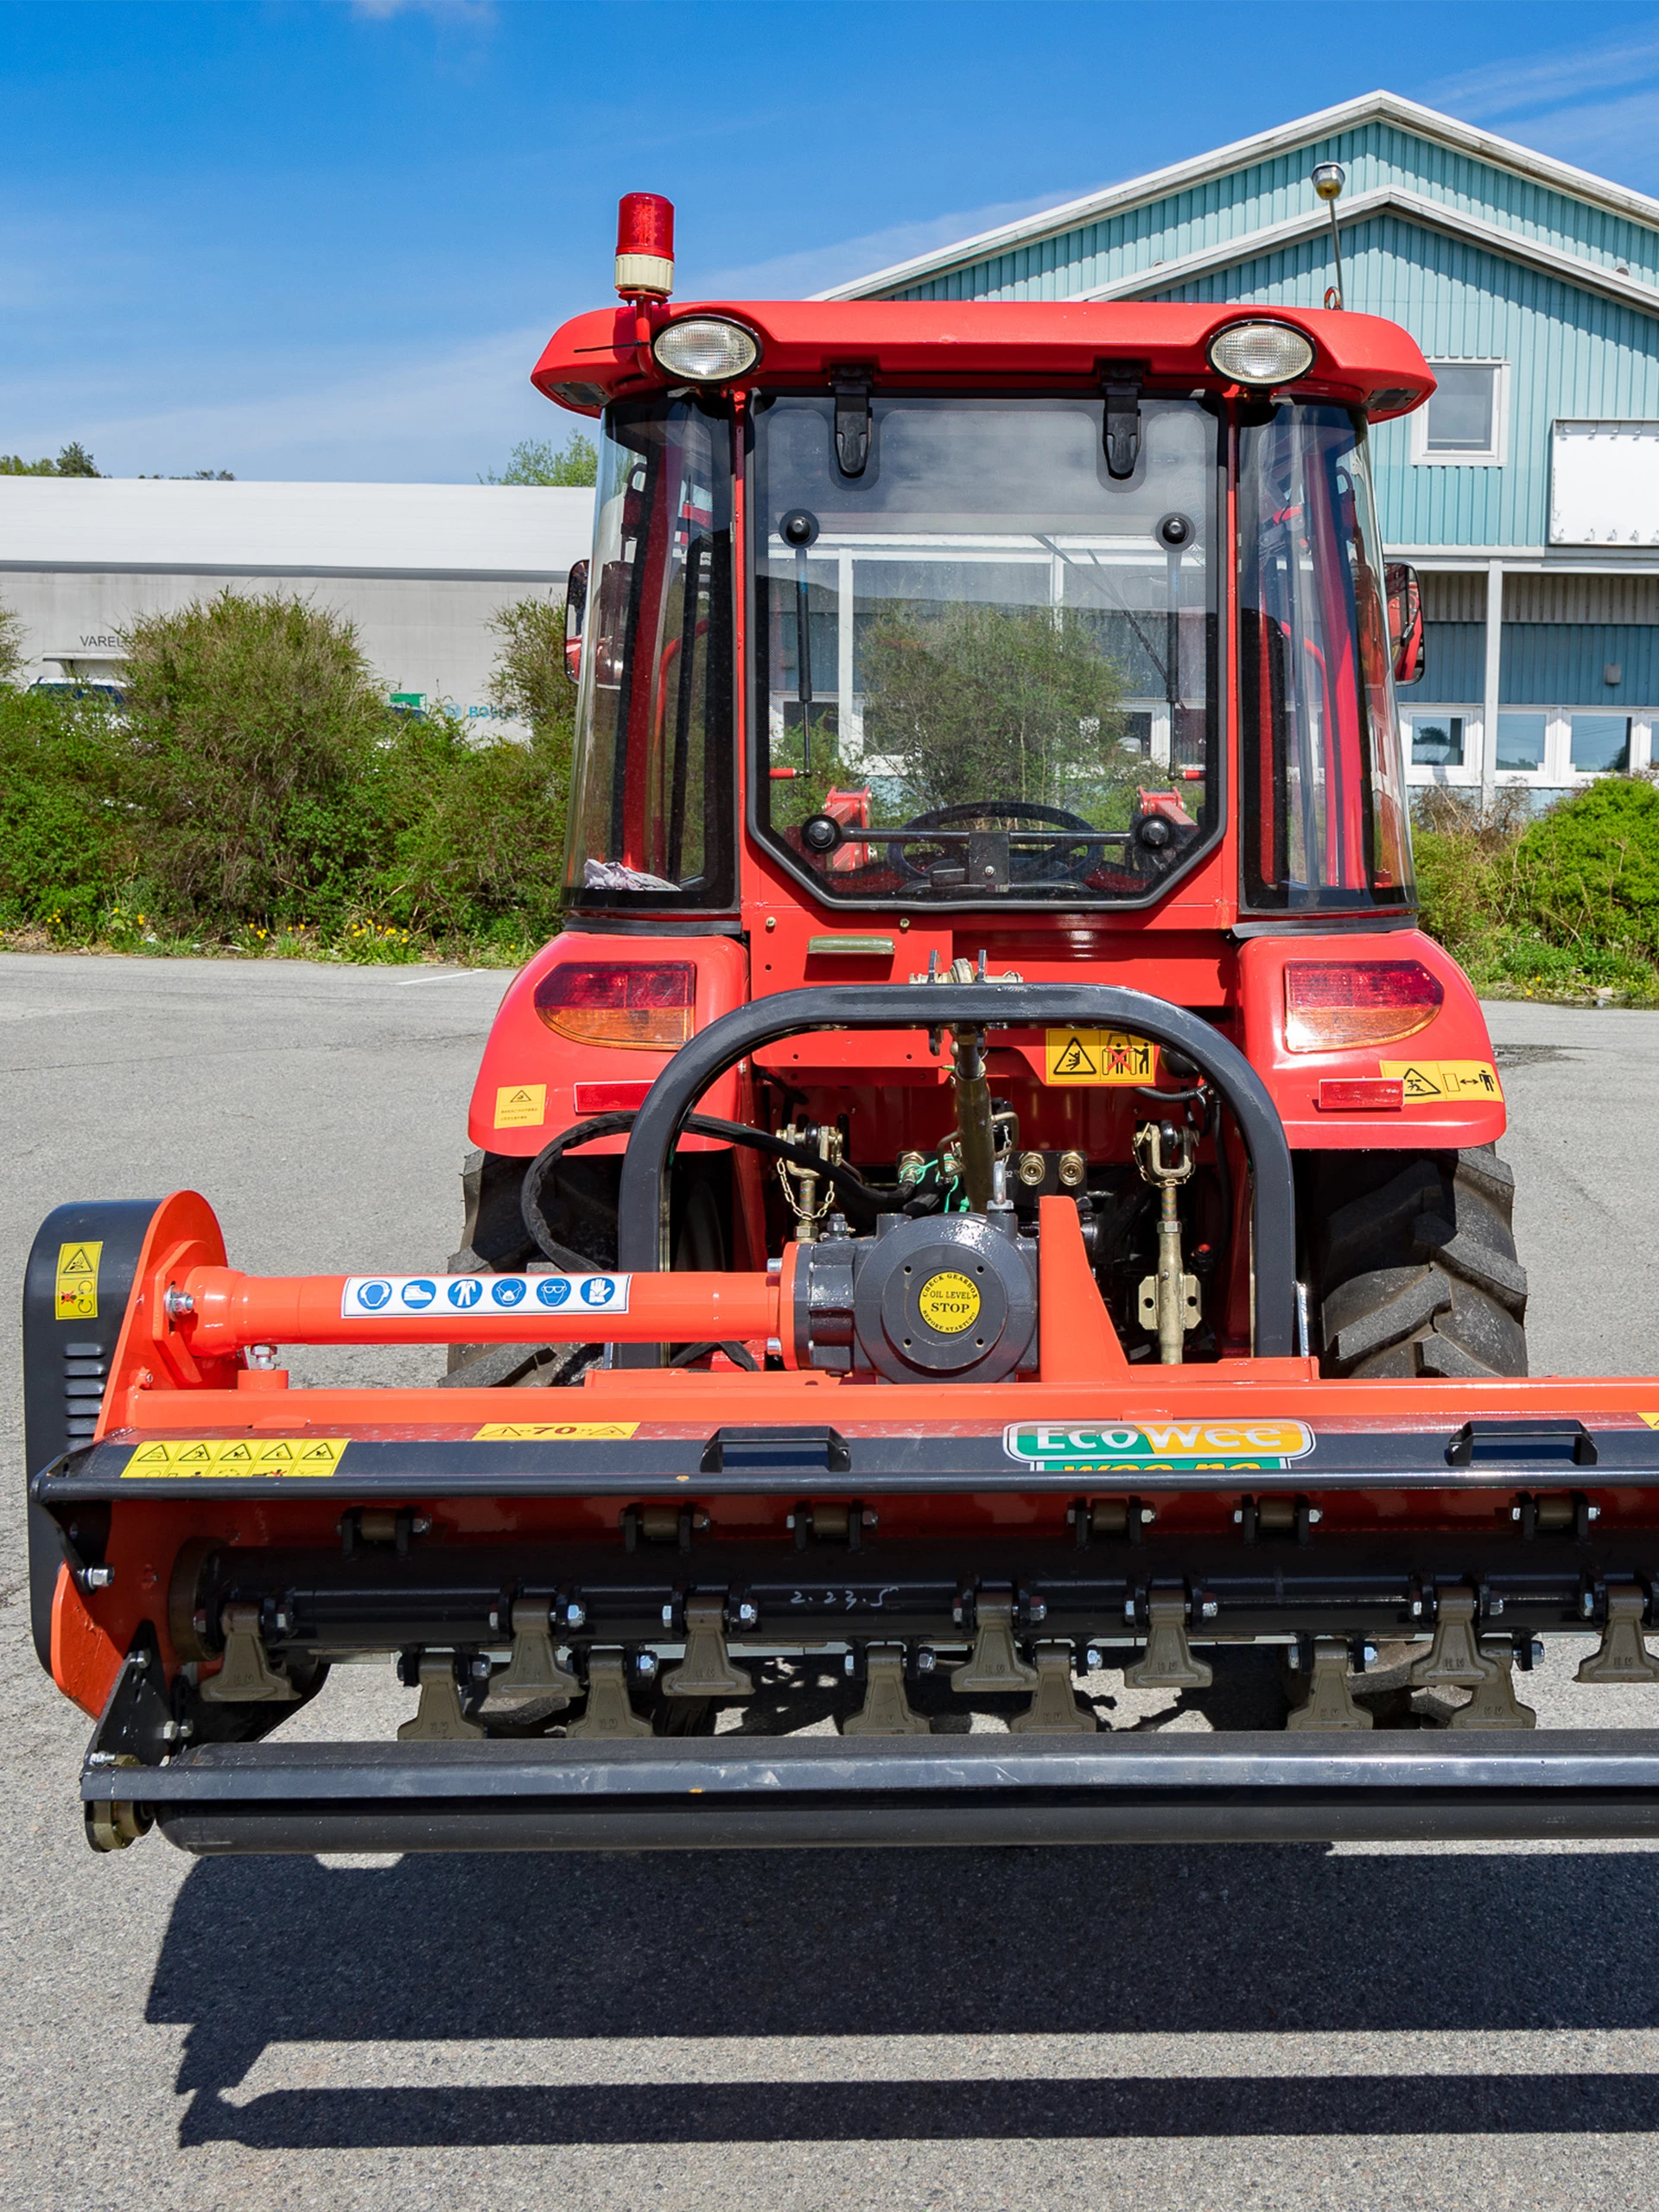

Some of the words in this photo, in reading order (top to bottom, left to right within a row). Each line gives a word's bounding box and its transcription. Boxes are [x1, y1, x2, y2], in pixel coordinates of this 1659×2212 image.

[923, 1275, 944, 1297] CHECK
[947, 1274, 978, 1298] GEARBOX
[945, 1291, 971, 1300] LEVEL
[931, 1302, 969, 1313] STOP
[923, 1310, 944, 1330] BEFORE
[532, 1426, 577, 1435] 70
